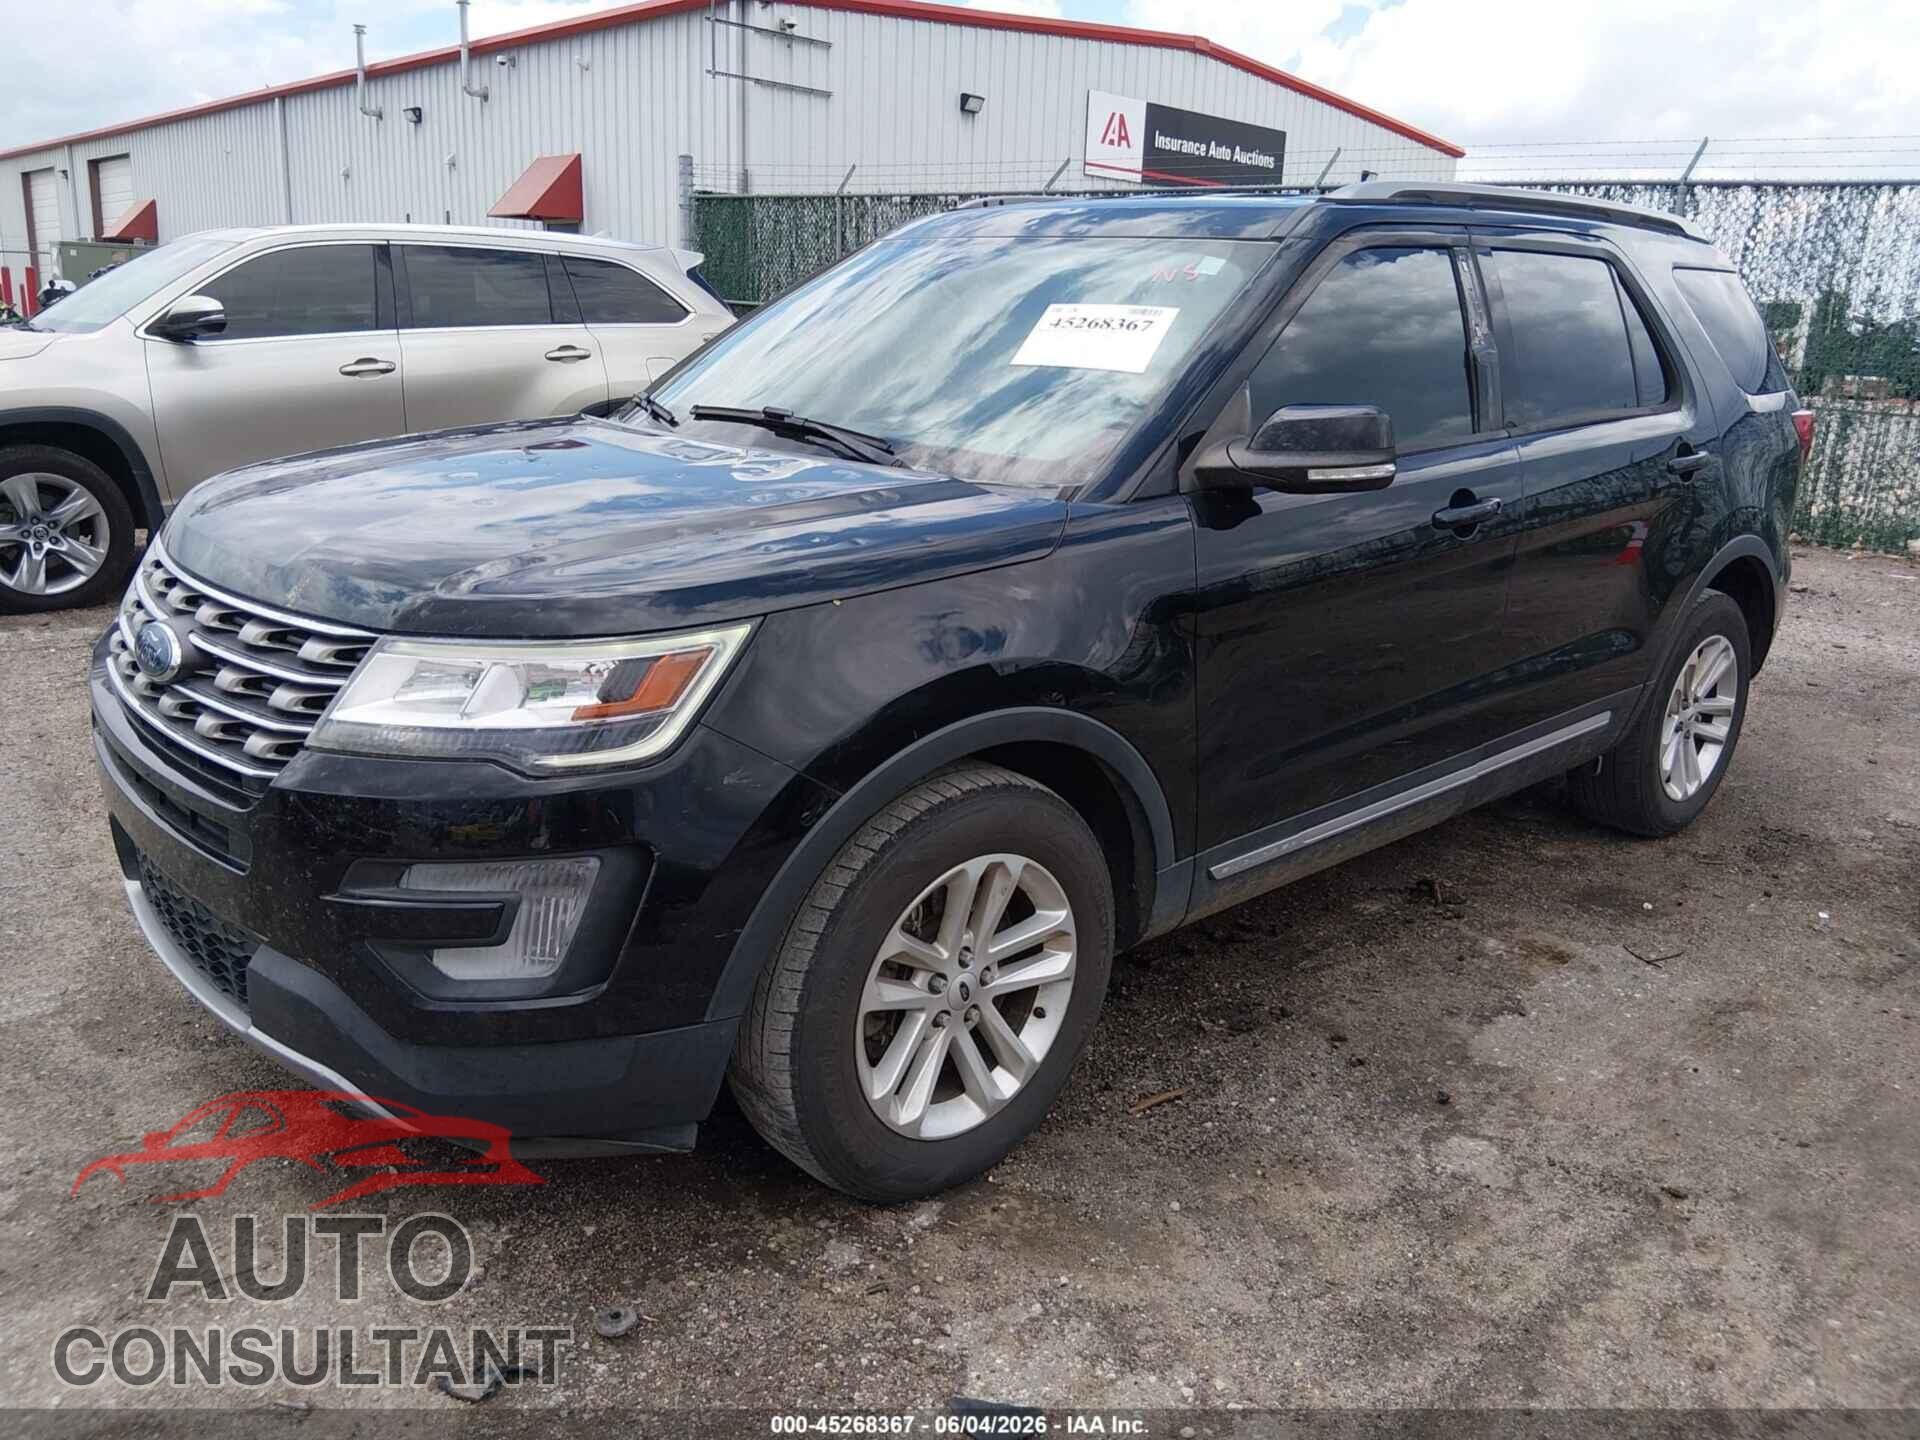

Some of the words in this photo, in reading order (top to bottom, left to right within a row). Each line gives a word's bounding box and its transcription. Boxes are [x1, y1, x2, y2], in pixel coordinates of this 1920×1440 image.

[1155, 130, 1206, 157] Insurance
[1208, 141, 1231, 161] Auto
[1232, 146, 1275, 169] Auctions
[1049, 316, 1155, 332] 45268367
